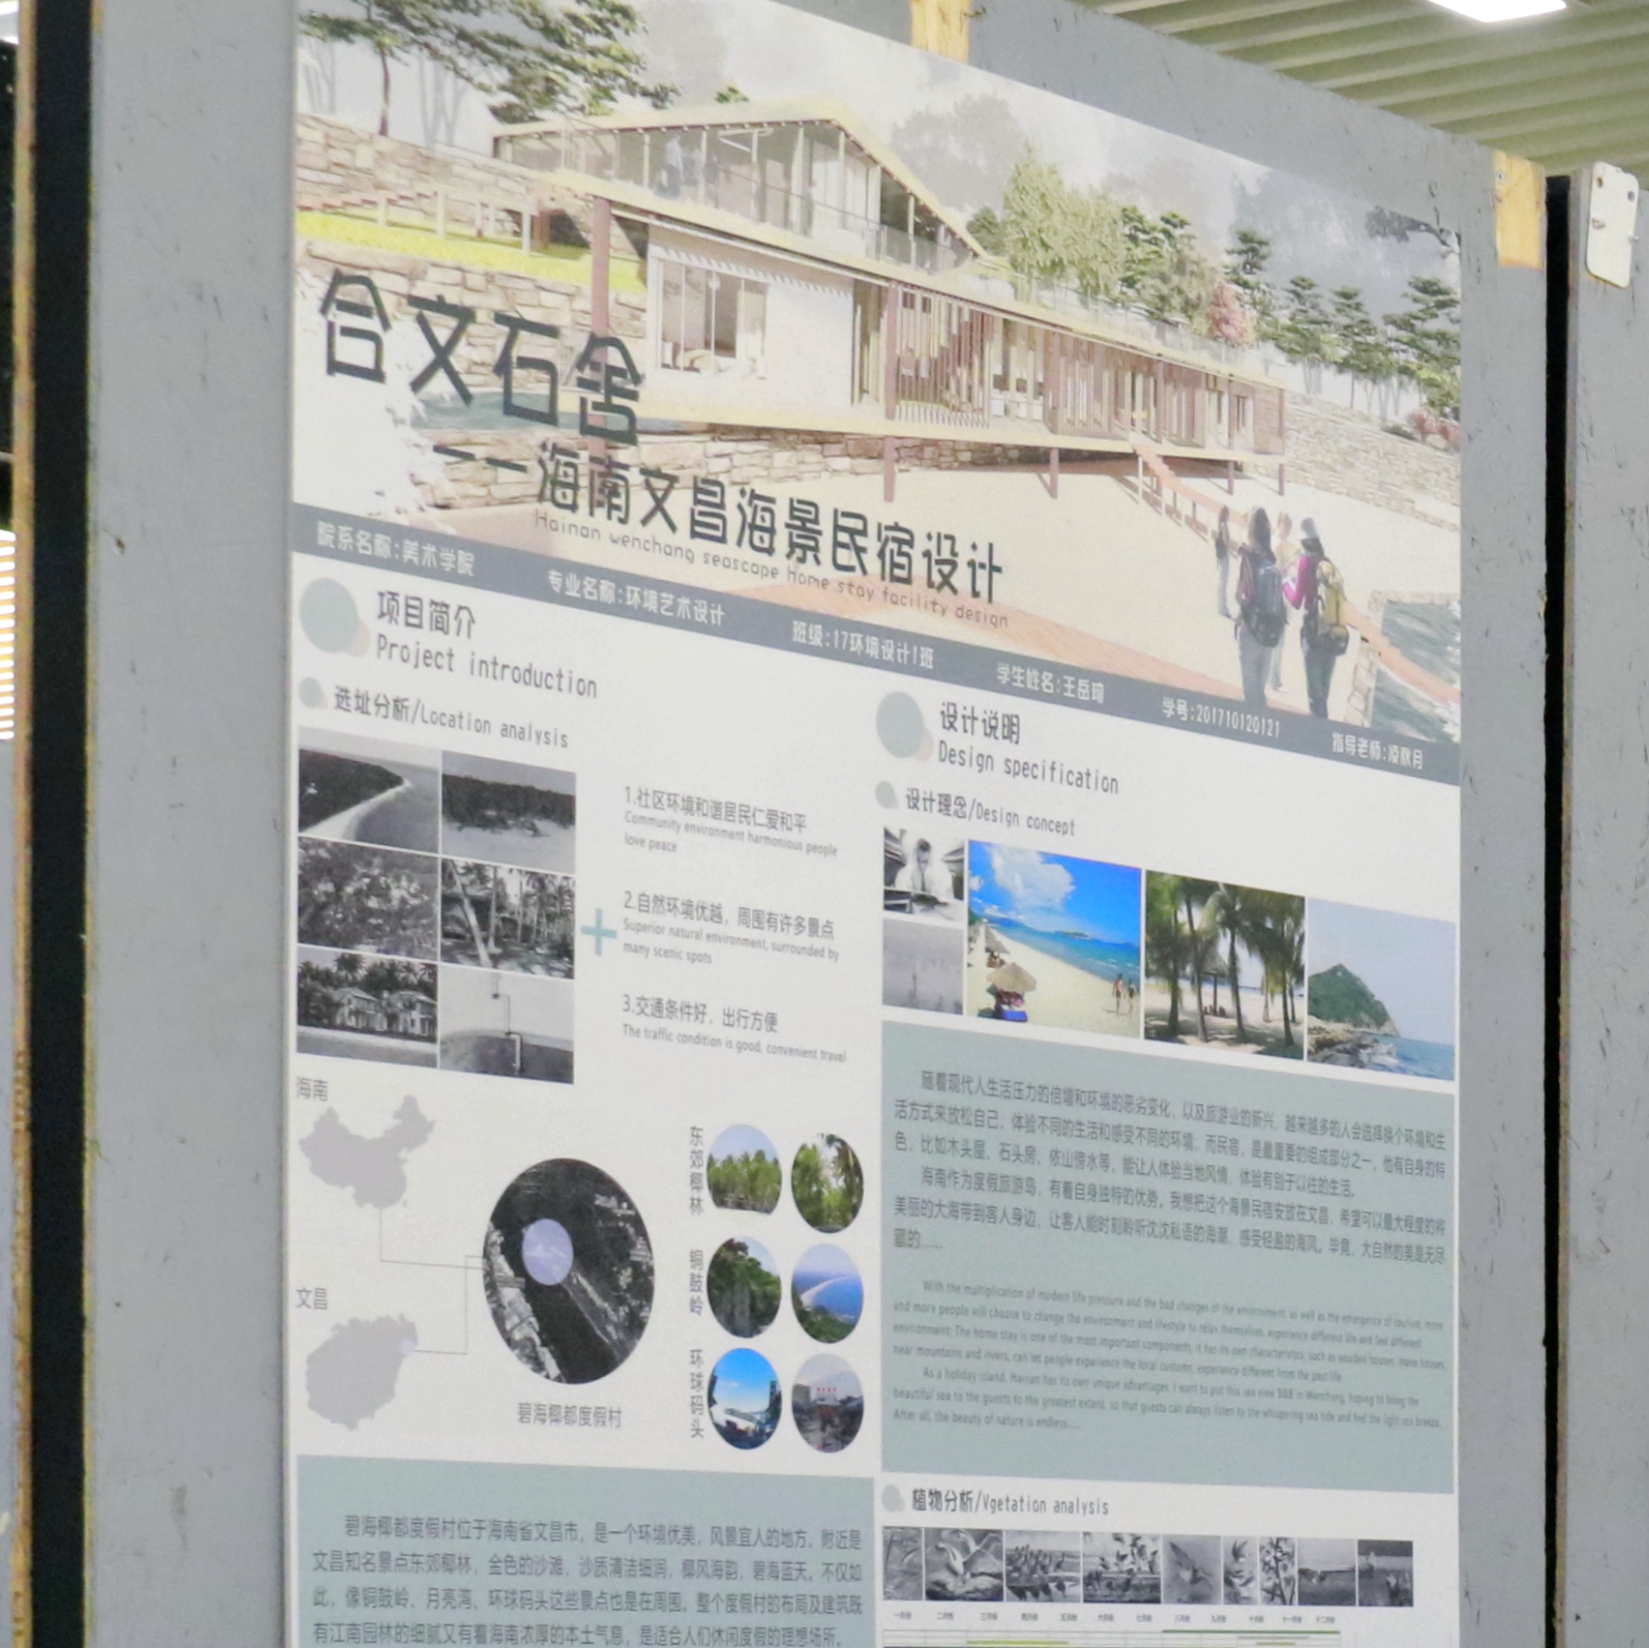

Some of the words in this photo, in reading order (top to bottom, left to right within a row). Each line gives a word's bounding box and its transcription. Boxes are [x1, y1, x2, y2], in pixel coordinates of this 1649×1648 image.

[319, 266, 644, 445] 合文石舍
[534, 509, 601, 544] Hainan
[610, 529, 696, 566] wenchang
[702, 551, 780, 581] seascape
[786, 561, 831, 590] home
[836, 575, 875, 602] stay
[881, 582, 949, 620] facility
[955, 603, 1009, 630] design
[377, 589, 476, 640] 项目简介
[377, 635, 455, 674] Project
[470, 648, 598, 699] introduction
[334, 685, 492, 736] 选址分析/Location
[500, 717, 569, 749] analysis
[938, 700, 1021, 745] 设计说明
[938, 741, 995, 774] Design
[1004, 753, 1120, 796] specification
[624, 810, 682, 833] Community
[684, 820, 745, 842] environment
[748, 830, 803, 852] harmonious
[806, 840, 838, 858] people
[905, 786, 1020, 828] 设计理念/Design
[1026, 812, 1076, 837] concept
[624, 832, 646, 848] love
[648, 838, 677, 853] peace
[624, 942, 651, 957] many
[653, 945, 684, 960] scenic
[686, 949, 712, 965] spots
[622, 1024, 640, 1038] The
[644, 1026, 673, 1042] traffic
[676, 1031, 722, 1048] condition
[725, 1036, 733, 1048] is
[766, 1041, 817, 1060] convenient
[820, 1049, 847, 1063] travel
[296, 1075, 329, 1104] 海南
[296, 1285, 328, 1311] 文昌
[1053, 1496, 1110, 1516] analysis
